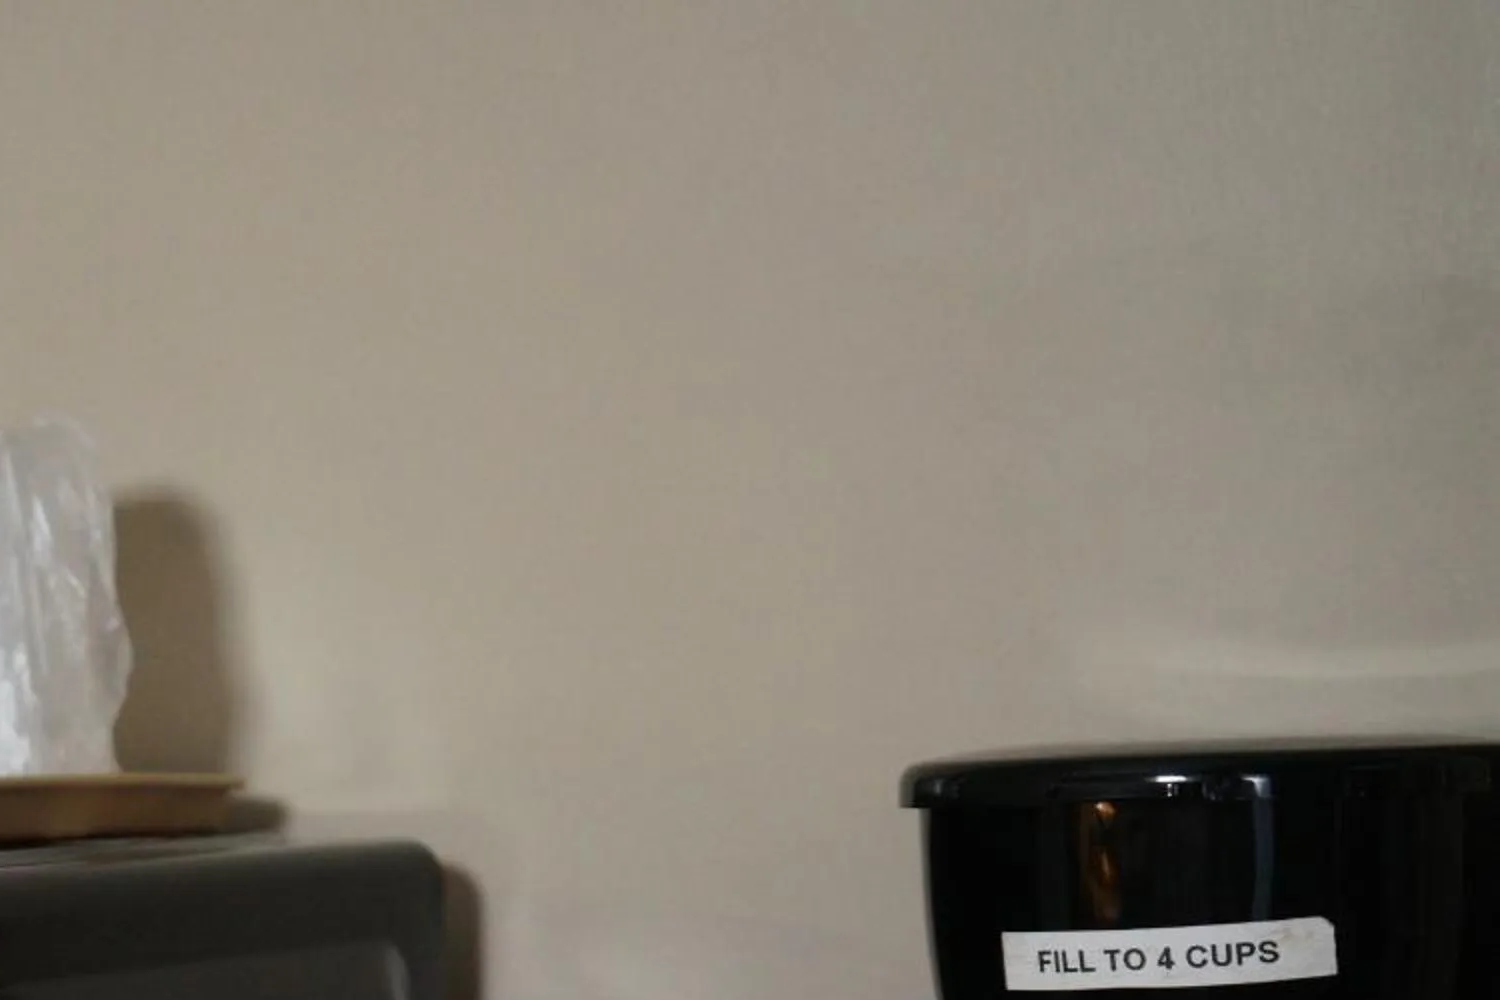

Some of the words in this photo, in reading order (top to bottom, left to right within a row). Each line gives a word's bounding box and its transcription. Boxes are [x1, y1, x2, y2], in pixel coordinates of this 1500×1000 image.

[1038, 950, 1096, 973] FILL
[1104, 948, 1146, 971] TO
[1157, 947, 1174, 970] 4
[1186, 941, 1280, 969] CUPS
